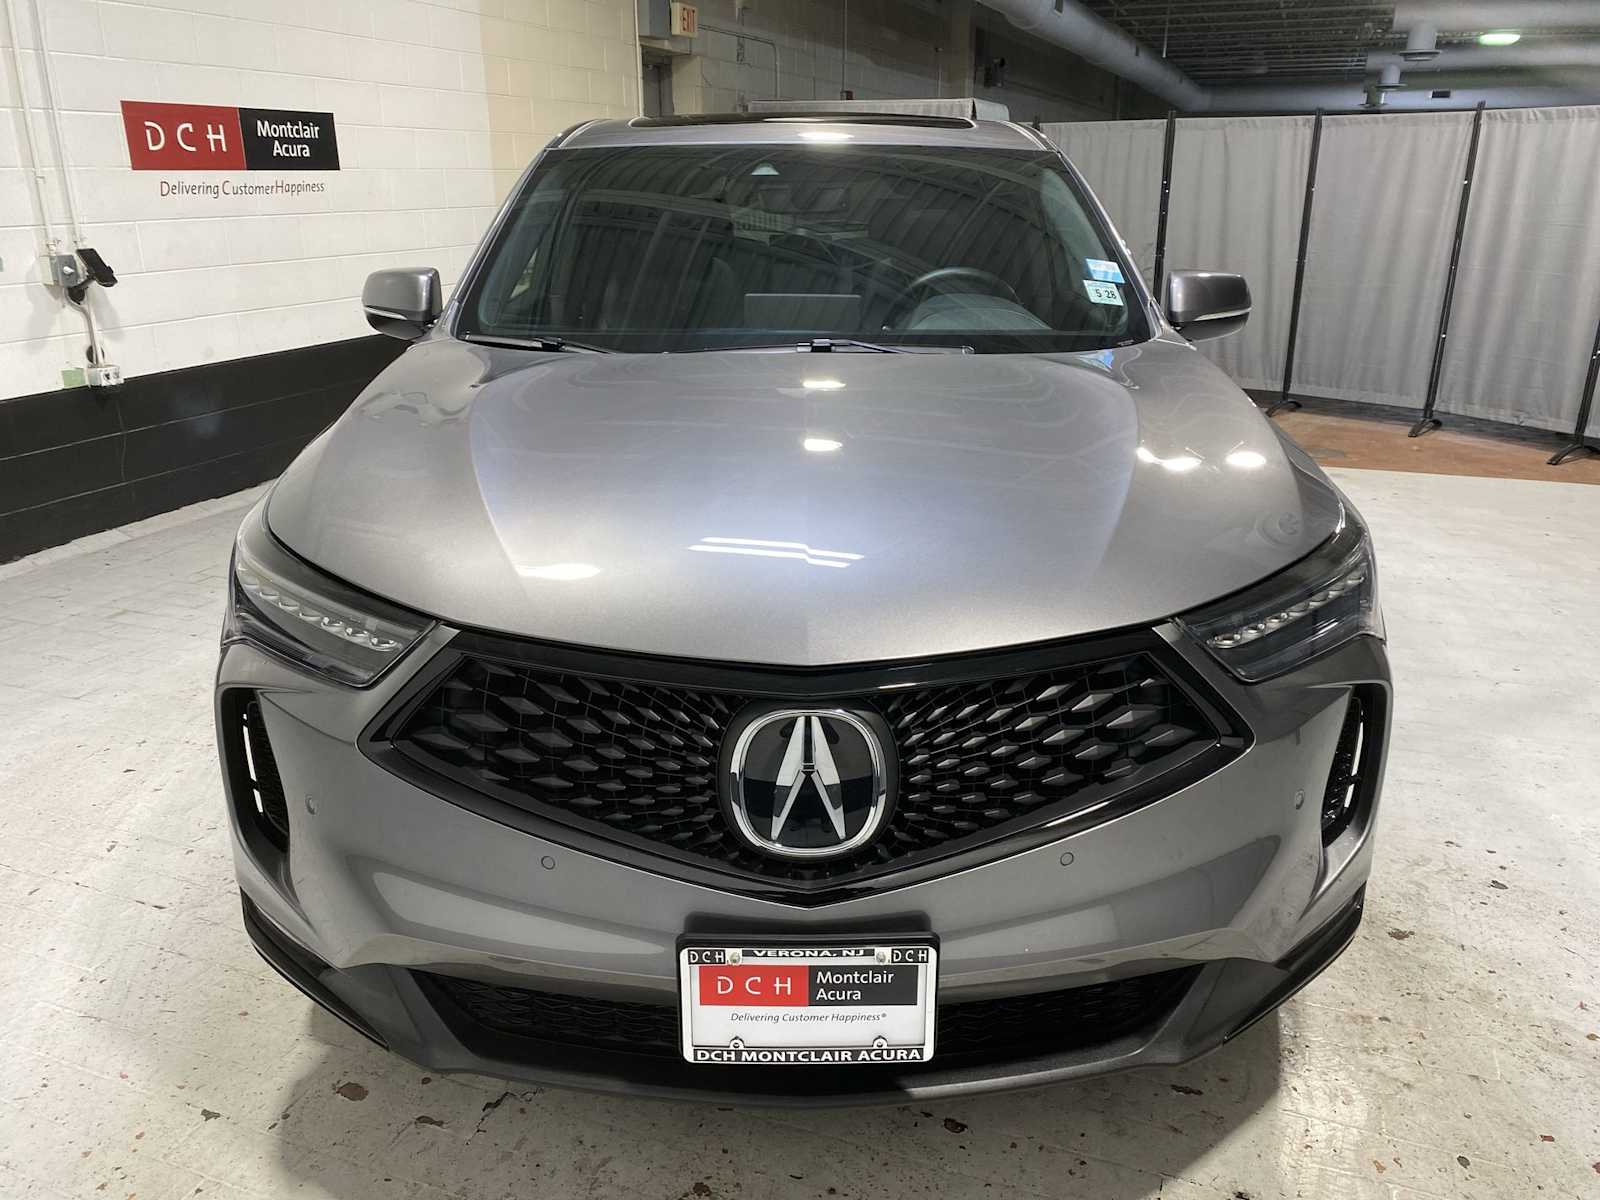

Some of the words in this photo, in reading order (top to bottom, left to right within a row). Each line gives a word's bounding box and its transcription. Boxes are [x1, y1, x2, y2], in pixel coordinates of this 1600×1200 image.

[257, 119, 320, 139] Montclair
[273, 140, 311, 157] Acura
[160, 181, 219, 199] Delivering
[753, 949, 837, 957] VERONA,
[842, 949, 864, 957] NJ
[816, 971, 894, 984] Montclair
[816, 988, 861, 1001] Acura
[731, 1012, 779, 1023] Delivering
[782, 1012, 827, 1022] Customer
[697, 1050, 736, 1062] DCH
[741, 1050, 852, 1062] MONTCLAIR
[858, 1049, 921, 1060] ACURA
